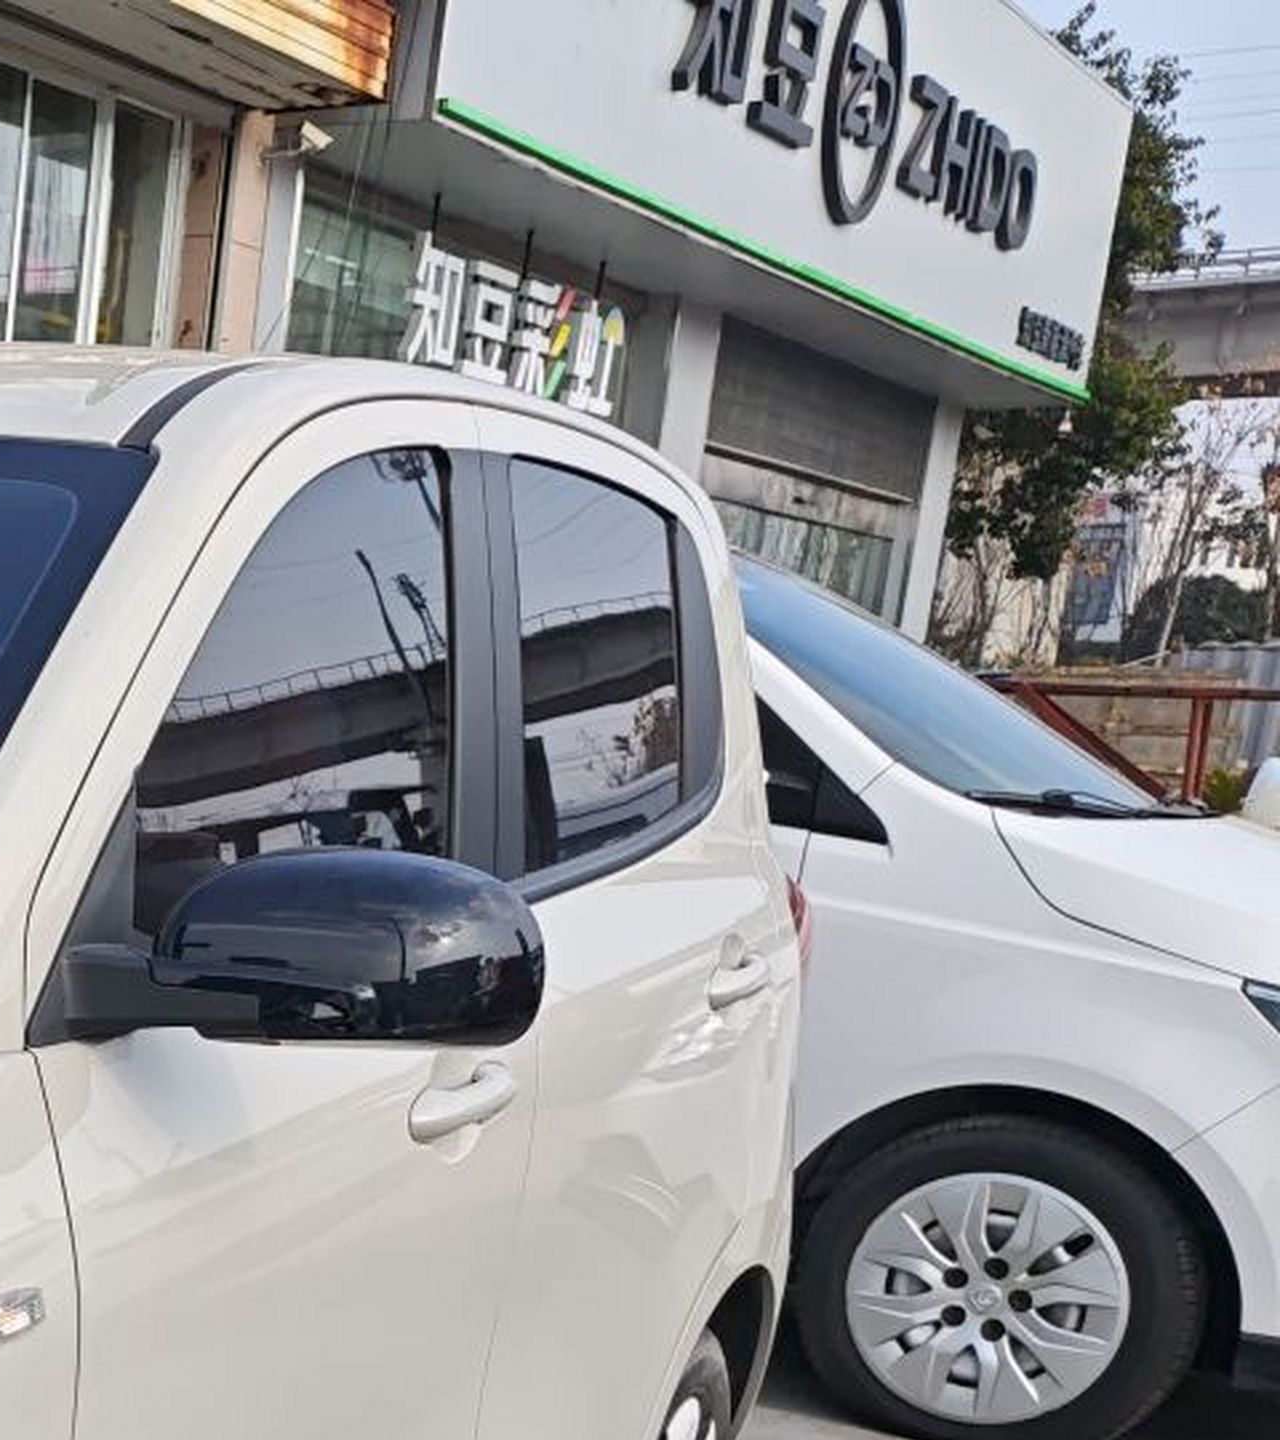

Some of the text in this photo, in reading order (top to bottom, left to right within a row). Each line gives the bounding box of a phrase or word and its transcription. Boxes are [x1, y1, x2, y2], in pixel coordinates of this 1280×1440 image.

[895, 75, 1038, 251] ZHIDO
[398, 231, 626, 417] 知豆彩虹
